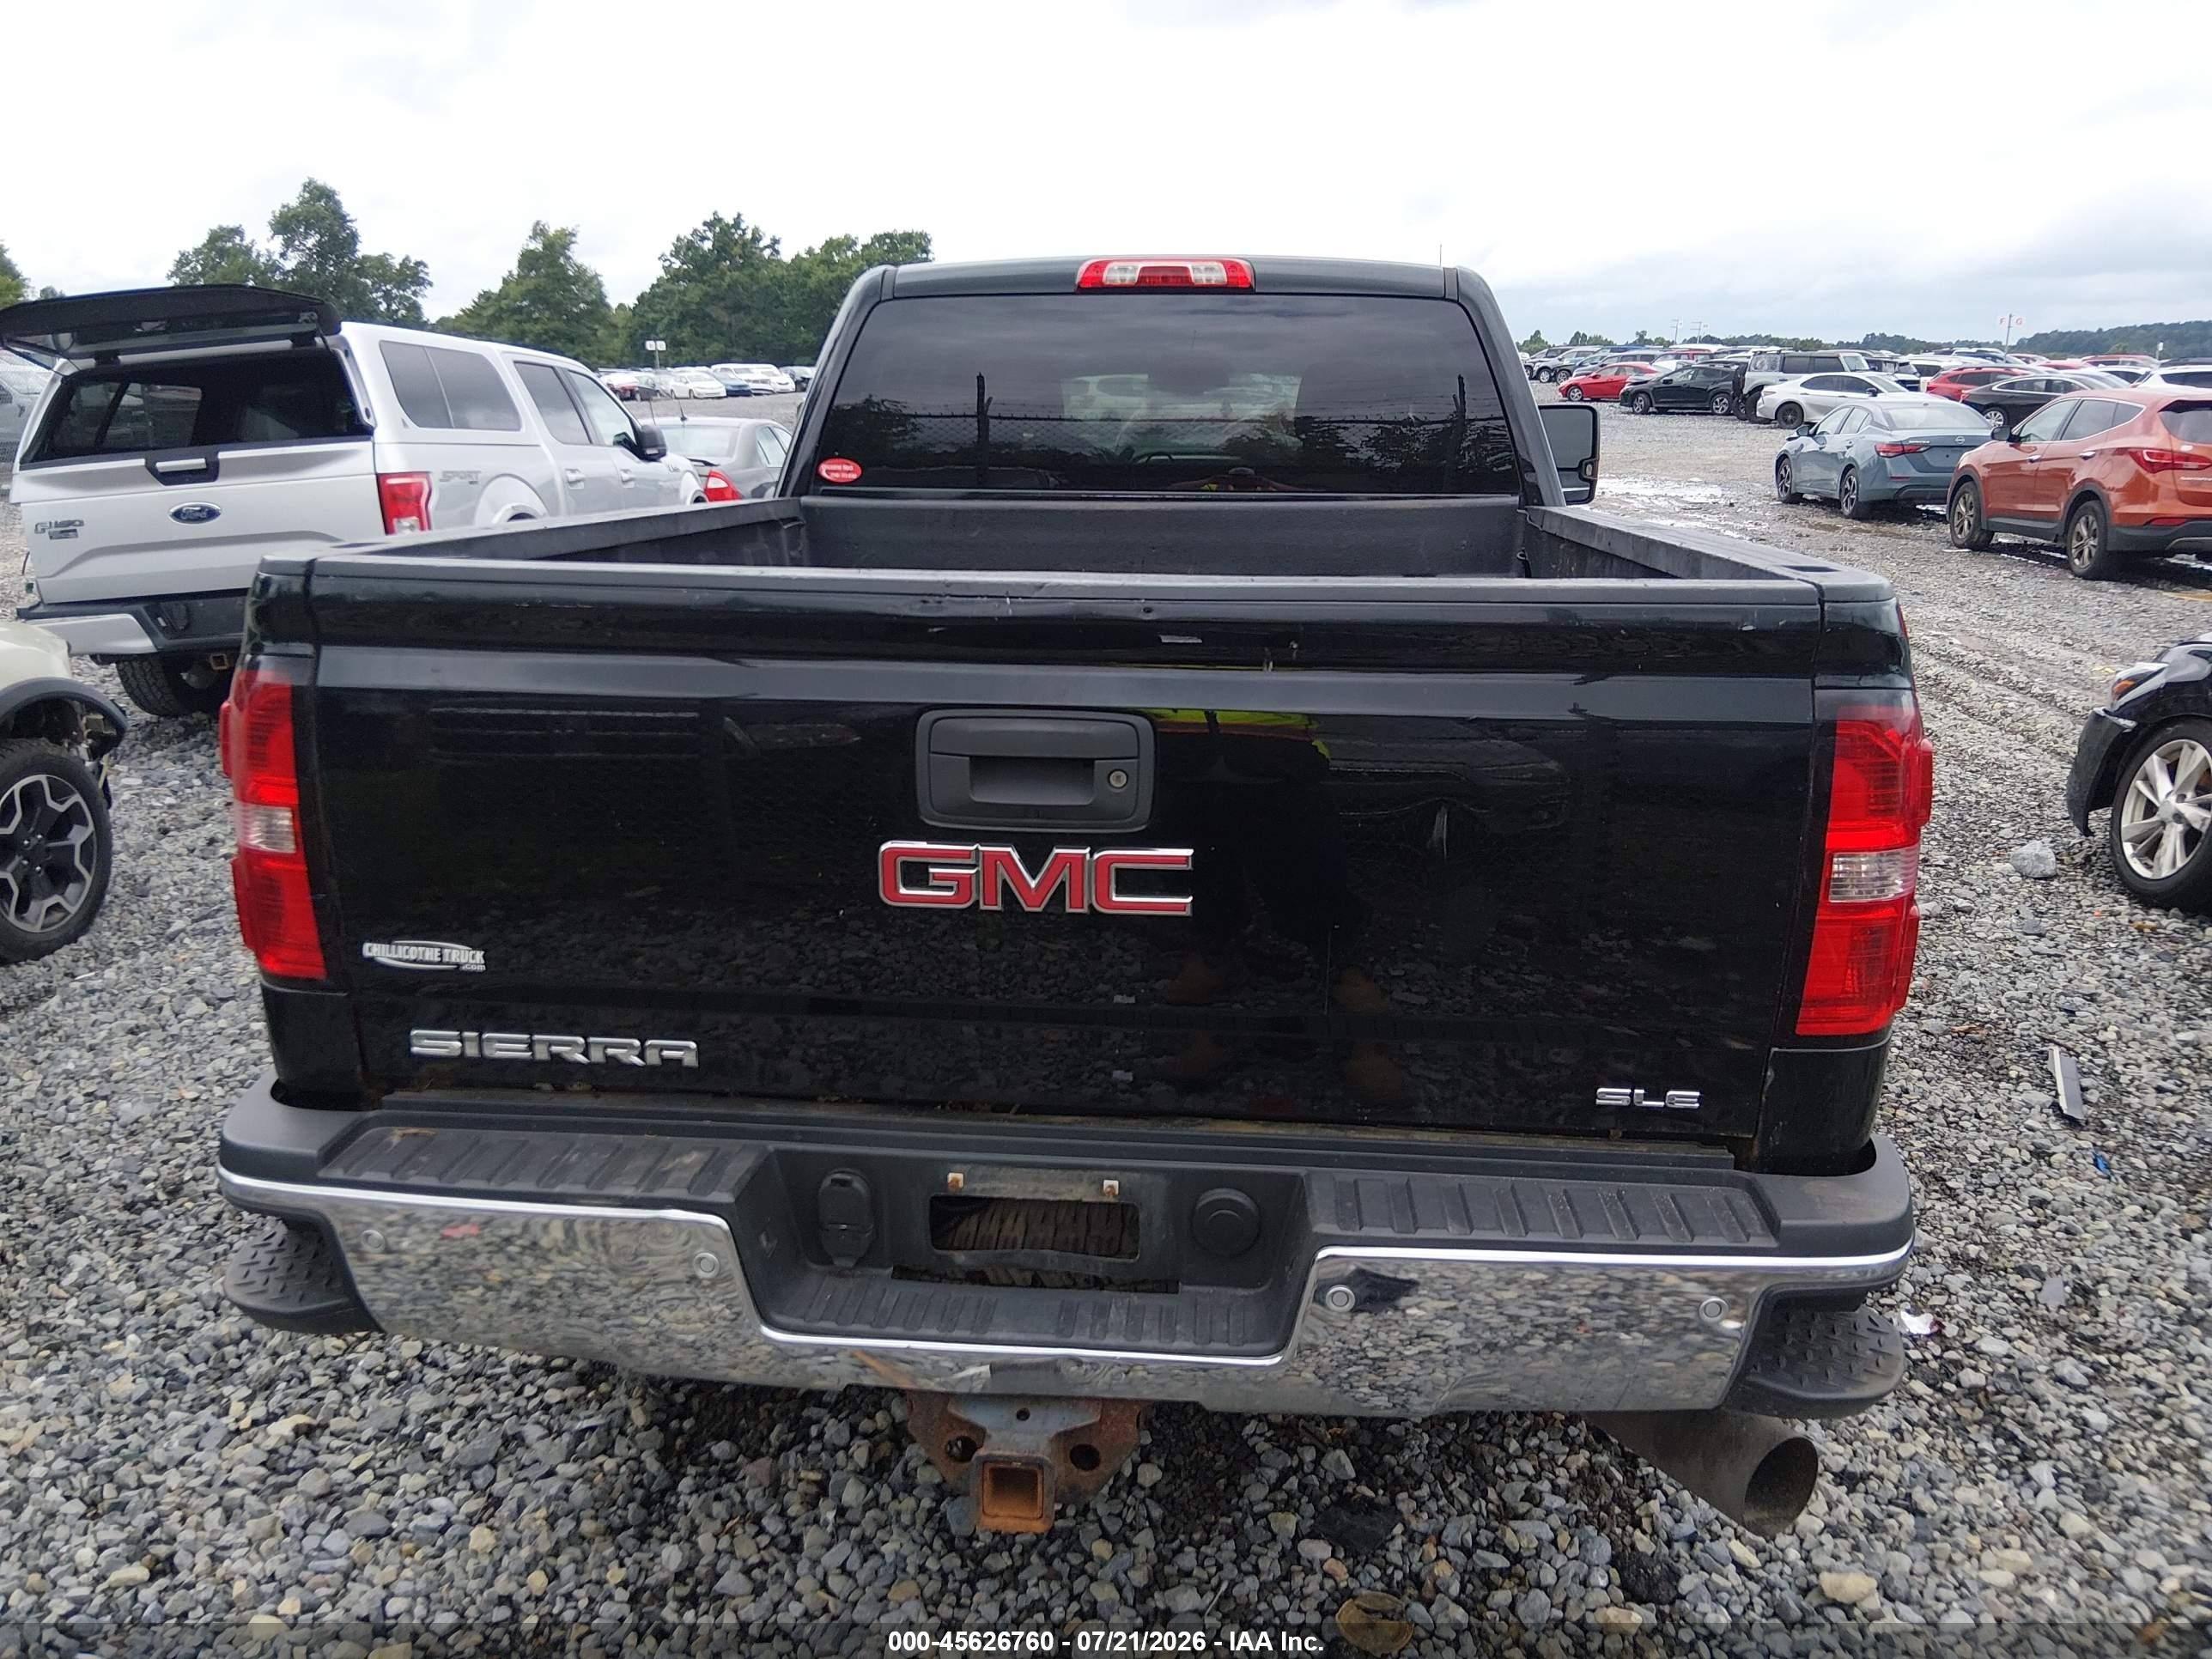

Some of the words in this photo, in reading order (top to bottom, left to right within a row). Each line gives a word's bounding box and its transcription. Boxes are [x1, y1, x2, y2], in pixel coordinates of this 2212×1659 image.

[439, 470, 482, 483] SPORT
[179, 506, 209, 520] Ford
[878, 840, 1194, 917] GMC
[362, 942, 441, 963] CHILLICOTHE
[442, 948, 486, 964] TRUCK
[461, 963, 487, 972] .com
[409, 1028, 700, 1068] SIERRA
[1595, 1087, 1701, 1109] SLE
